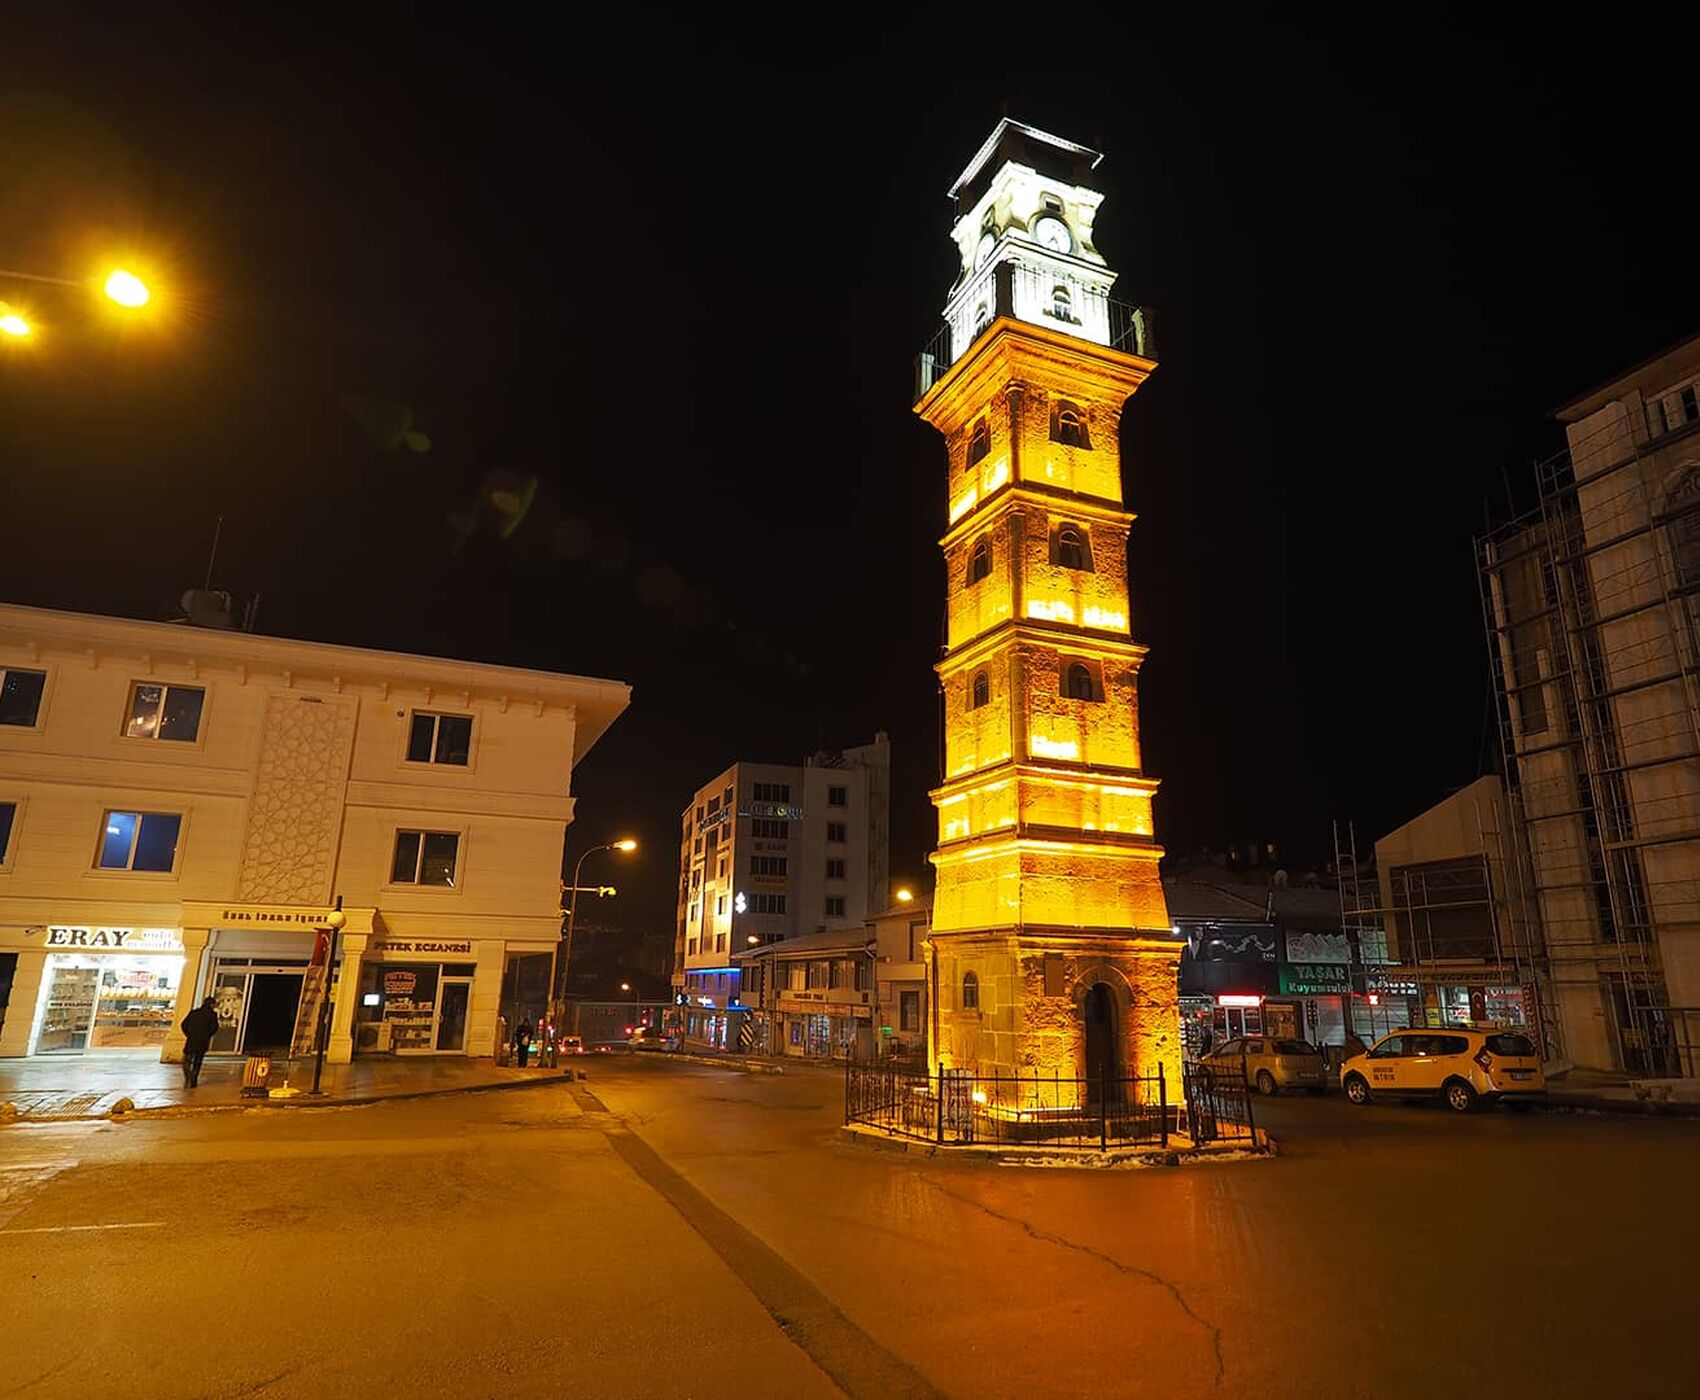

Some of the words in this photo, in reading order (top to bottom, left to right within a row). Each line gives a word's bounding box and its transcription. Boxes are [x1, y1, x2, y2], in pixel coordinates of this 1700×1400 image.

[48, 928, 129, 946] ERAY
[415, 942, 471, 953] ECZANESİ
[1297, 966, 1345, 982] YAŞAR
